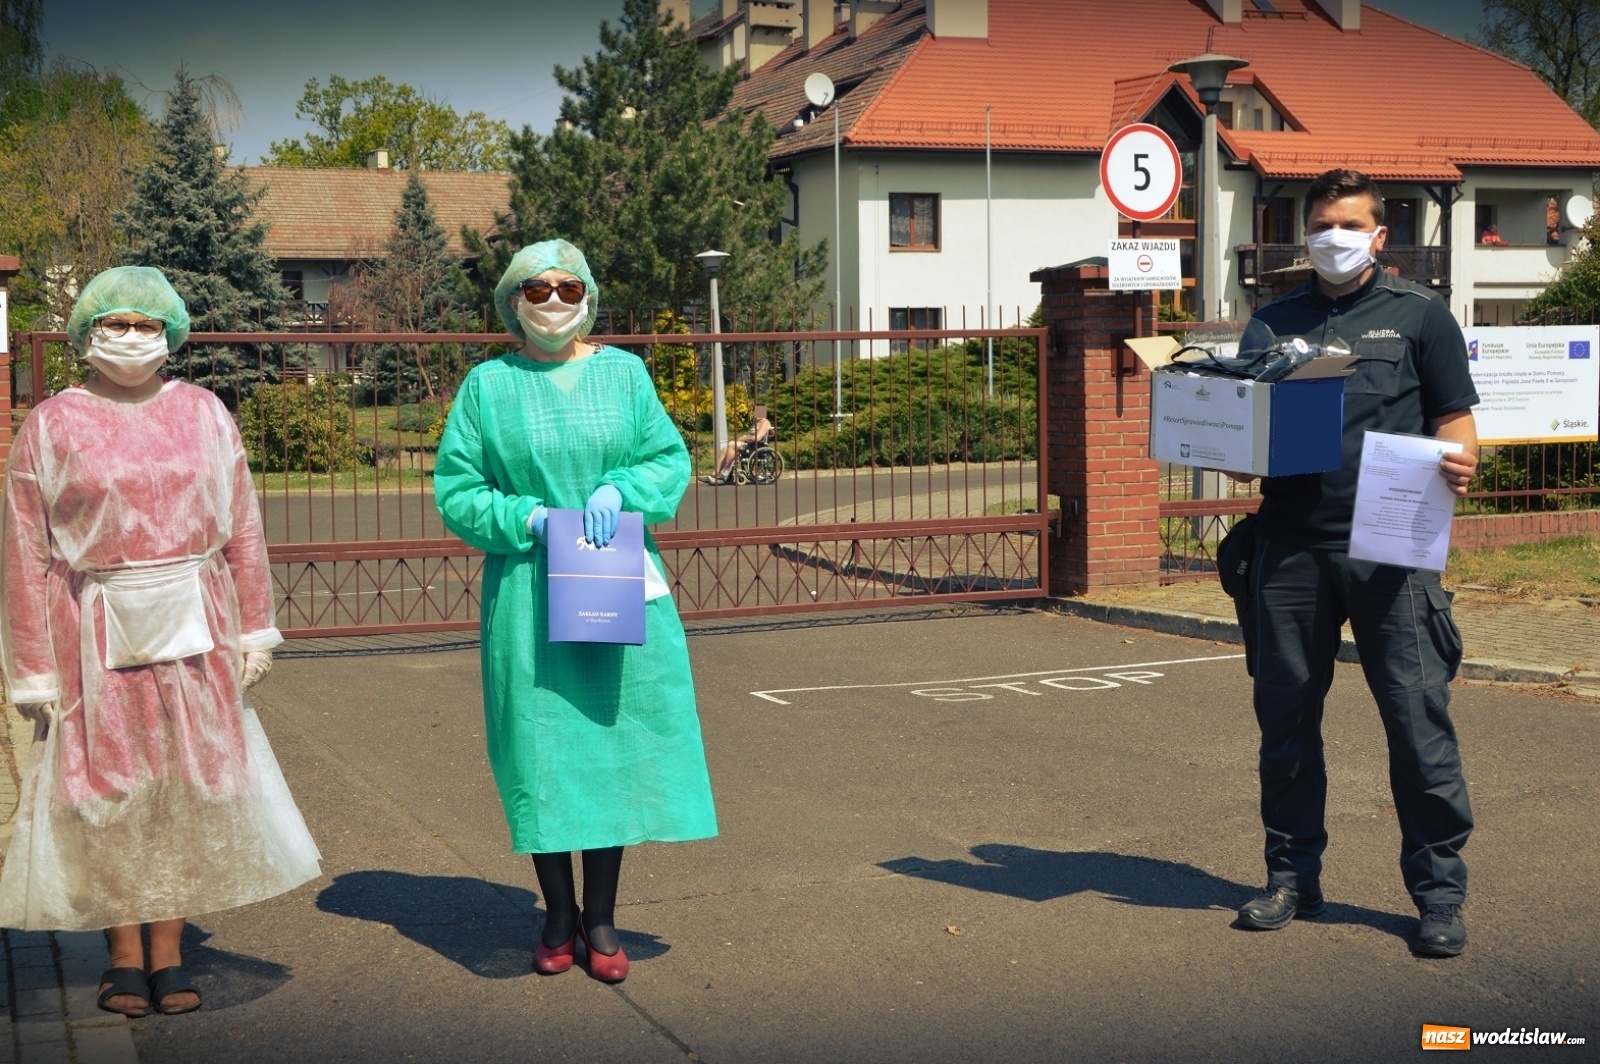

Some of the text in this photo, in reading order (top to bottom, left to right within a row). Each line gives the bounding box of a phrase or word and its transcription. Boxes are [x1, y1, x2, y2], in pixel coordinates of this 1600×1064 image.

[1133, 153, 1151, 192] 5
[1111, 242, 1176, 251] ZAKAZ WJAZDU
[1236, 560, 1248, 576] SW
[909, 671, 1165, 702] STOP
